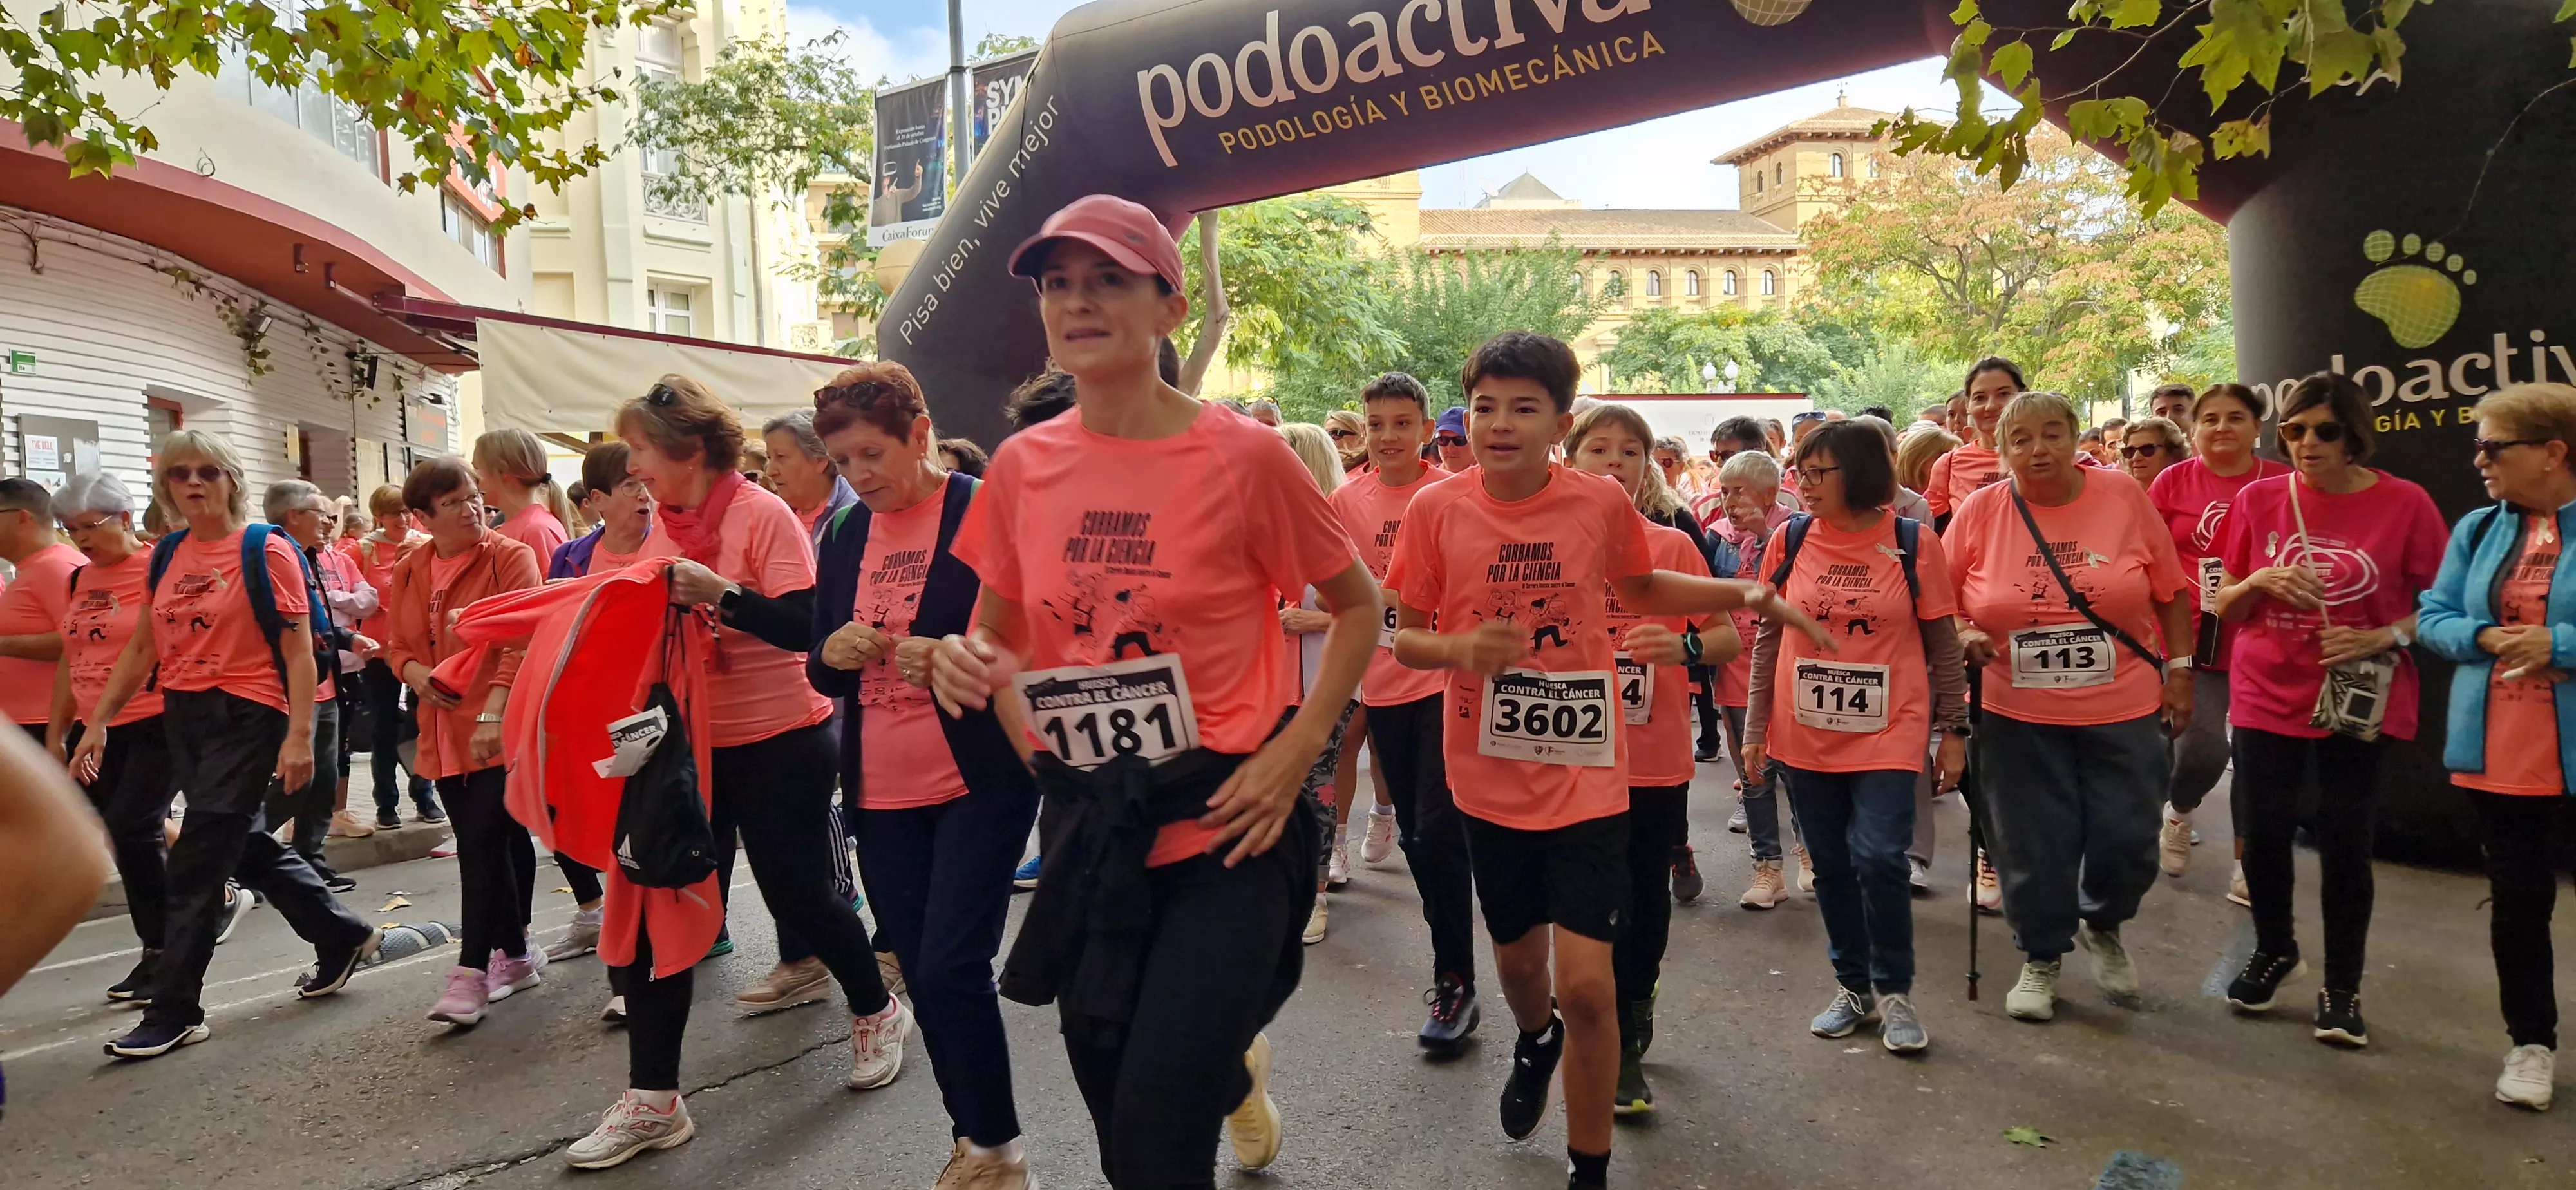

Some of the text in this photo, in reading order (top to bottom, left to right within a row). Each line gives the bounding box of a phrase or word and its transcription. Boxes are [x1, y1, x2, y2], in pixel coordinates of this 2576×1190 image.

[1218, 30, 1665, 155] PODOLOGÍA Y BIOMECÁNICA
[899, 95, 1059, 345] Pisa bien, vive mejor
[2434, 410, 2445, 426] Y
[1375, 534, 1388, 547] POR
[1498, 542, 1554, 563] CORRAMOS
[2025, 555, 2042, 567] POR
[886, 569, 899, 583] LA
[899, 564, 928, 583] CIENCI
[1486, 562, 1561, 583] POR LA CIENCIA
[1828, 564, 1870, 577] CORRAMOS
[1815, 575, 1873, 588] POR LA CIENCIA
[2022, 639, 2058, 647] CONTRA
[2070, 635, 2102, 643] CÁNCER
[2034, 646, 2096, 669] 113
[1077, 677, 1120, 690] HUESCA
[1539, 679, 1567, 690] HUESCA
[1803, 672, 1833, 682] CONTRA
[1846, 676, 1879, 685] CÁNCER
[1035, 681, 1171, 709] CONTRA EL CÁNCER
[1501, 684, 1601, 699] CONTRA EL CÁNCER
[1811, 685, 1869, 713] 114
[1495, 699, 1603, 739] 3602
[1044, 703, 1176, 760] 1181
